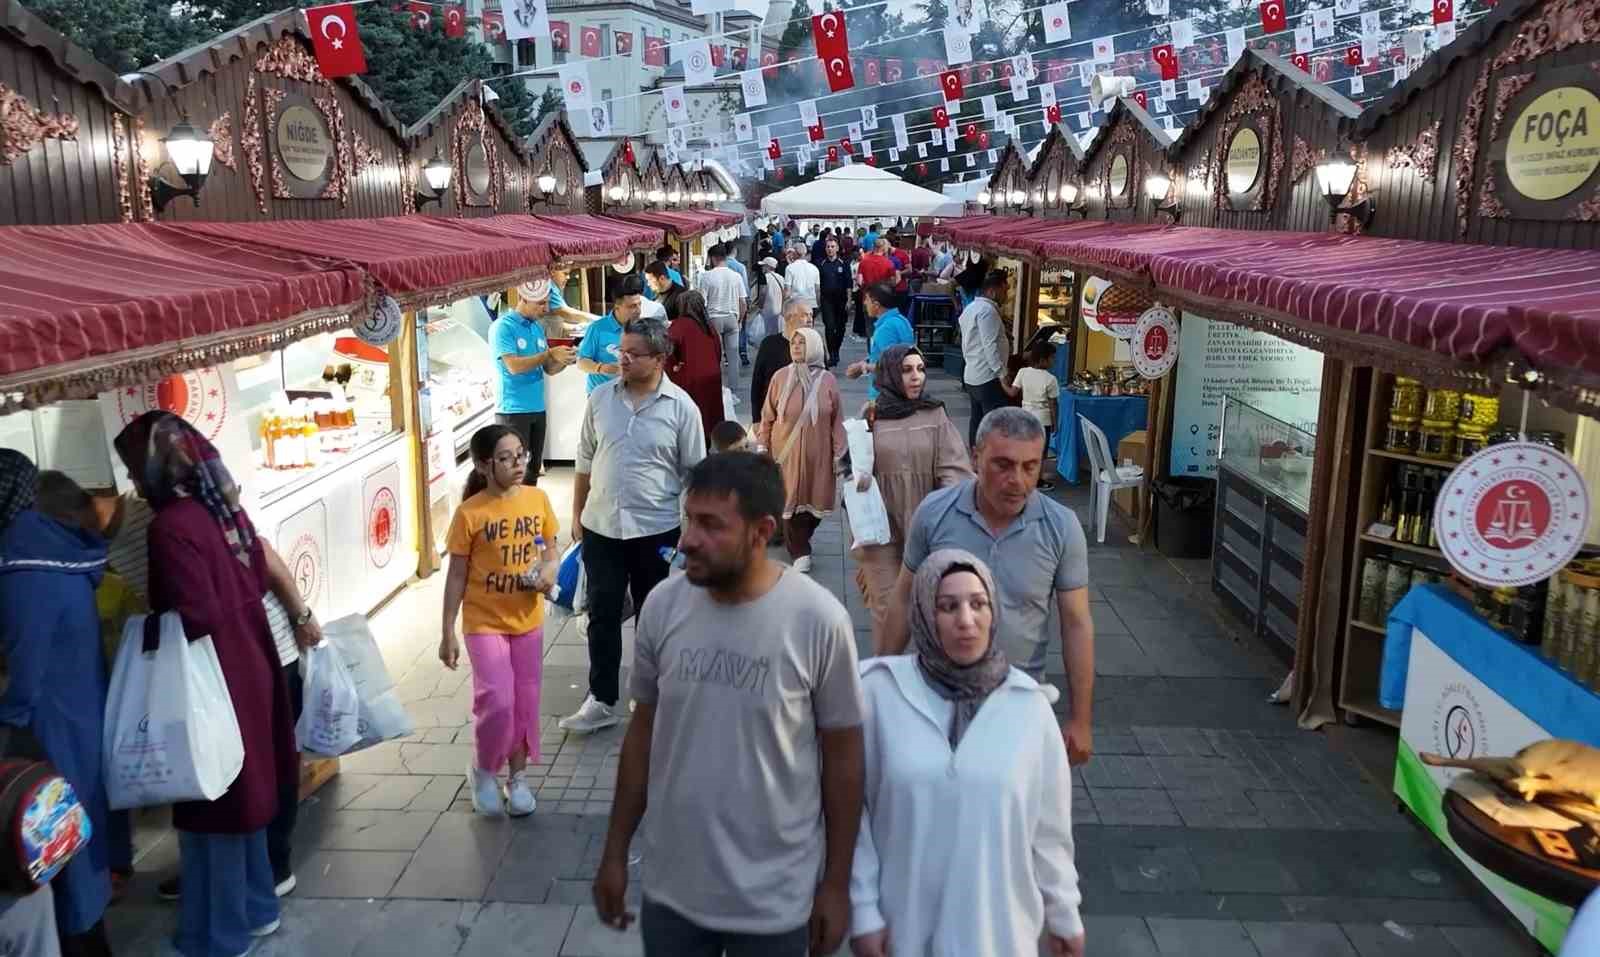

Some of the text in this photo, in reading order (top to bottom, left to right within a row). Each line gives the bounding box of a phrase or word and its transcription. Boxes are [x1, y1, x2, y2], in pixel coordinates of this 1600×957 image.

[1523, 106, 1588, 147] FOÇA
[484, 515, 541, 542] WE ARE
[501, 542, 532, 566] THE
